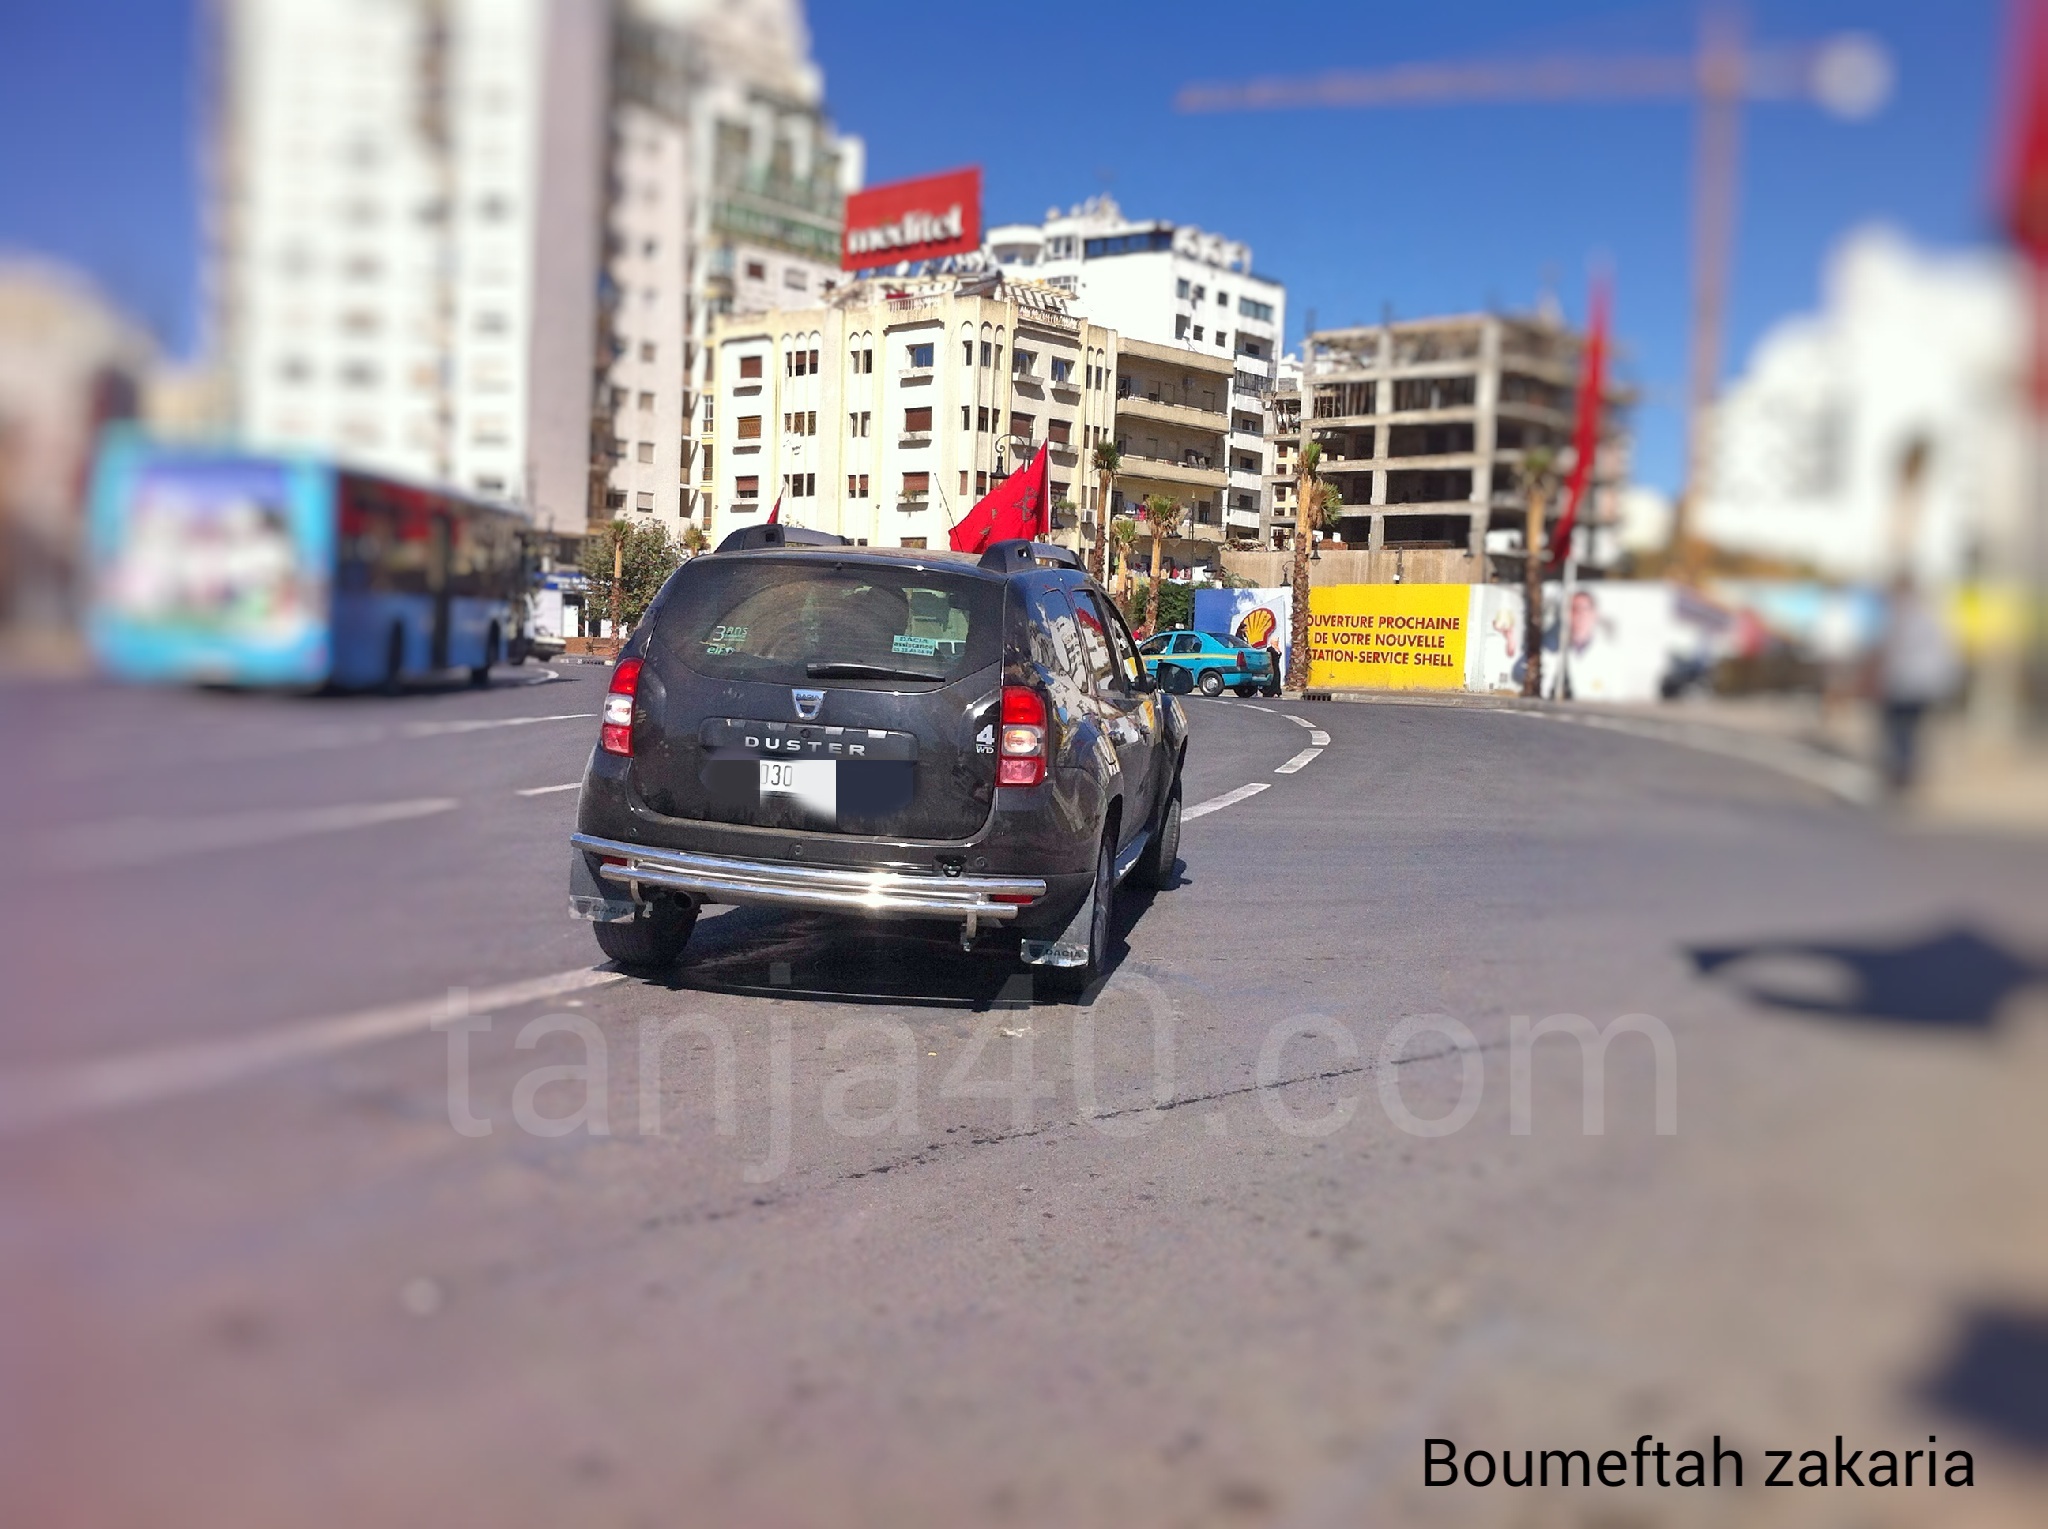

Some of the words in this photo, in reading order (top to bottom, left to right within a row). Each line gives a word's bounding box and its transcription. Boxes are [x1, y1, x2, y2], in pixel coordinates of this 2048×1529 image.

[848, 203, 963, 255] meditel
[1378, 616, 1460, 630] PROCHAINE
[1314, 632, 1328, 644] DE
[1332, 633, 1371, 646] VOTRE
[1375, 634, 1445, 648] NOUVELLE
[1414, 653, 1454, 667] SHELL
[744, 735, 867, 757] DUSTER
